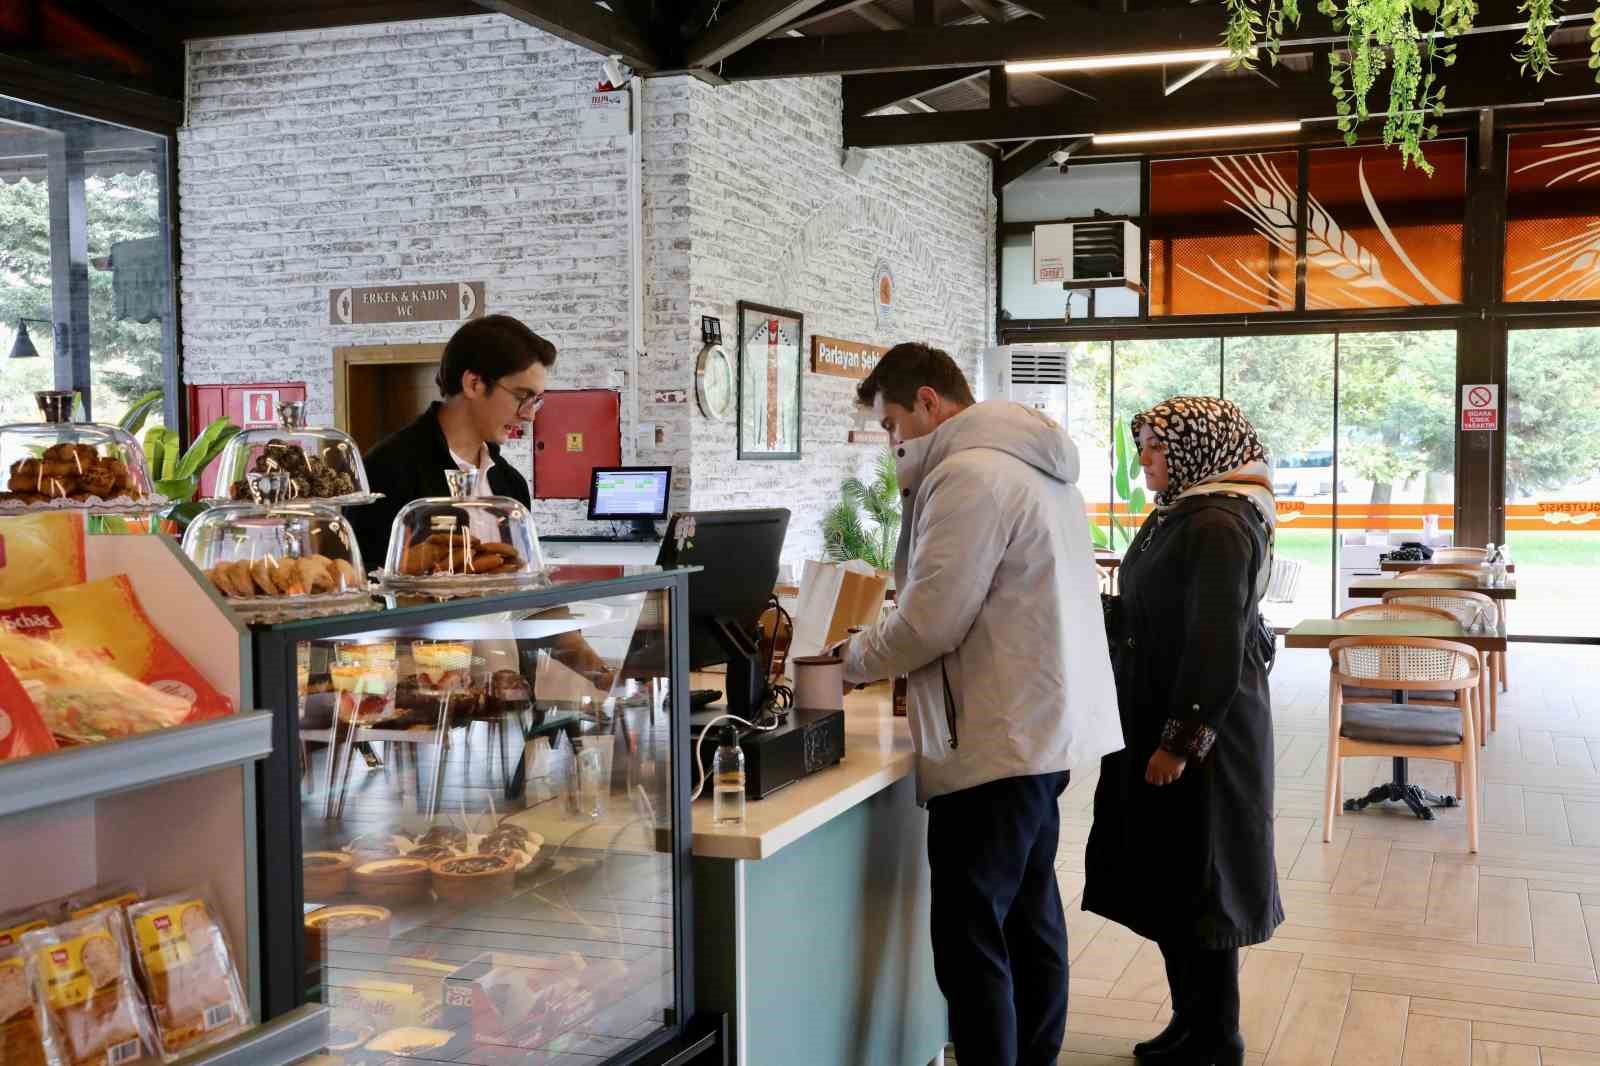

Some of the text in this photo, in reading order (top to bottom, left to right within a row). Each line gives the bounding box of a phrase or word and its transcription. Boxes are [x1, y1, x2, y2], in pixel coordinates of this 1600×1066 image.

[362, 288, 448, 304] ERKEK & KADIN
[397, 306, 413, 317] WC
[818, 342, 859, 371] Parlayan
